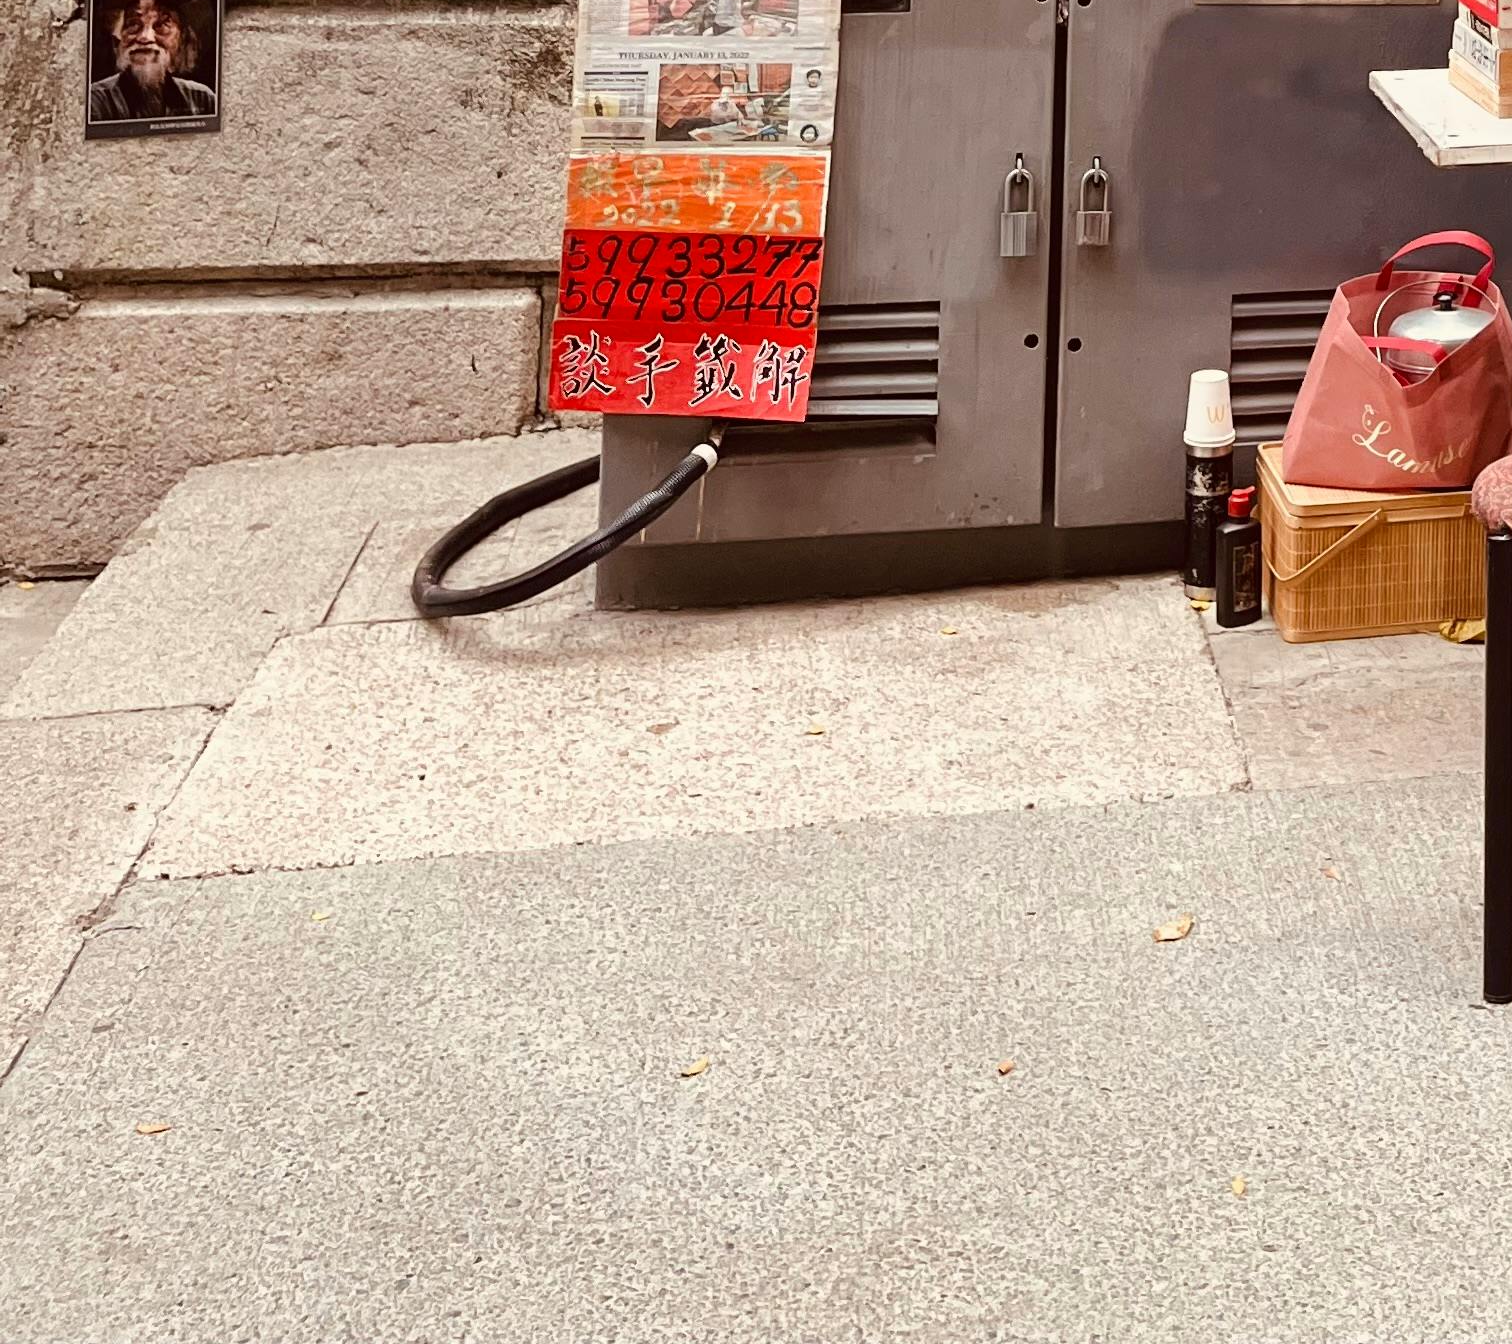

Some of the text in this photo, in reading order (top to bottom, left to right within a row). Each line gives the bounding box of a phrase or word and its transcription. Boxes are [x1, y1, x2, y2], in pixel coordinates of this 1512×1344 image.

[672, 51, 716, 61] JANUARY
[566, 234, 823, 282] 59933277
[560, 278, 818, 329] 59930448
